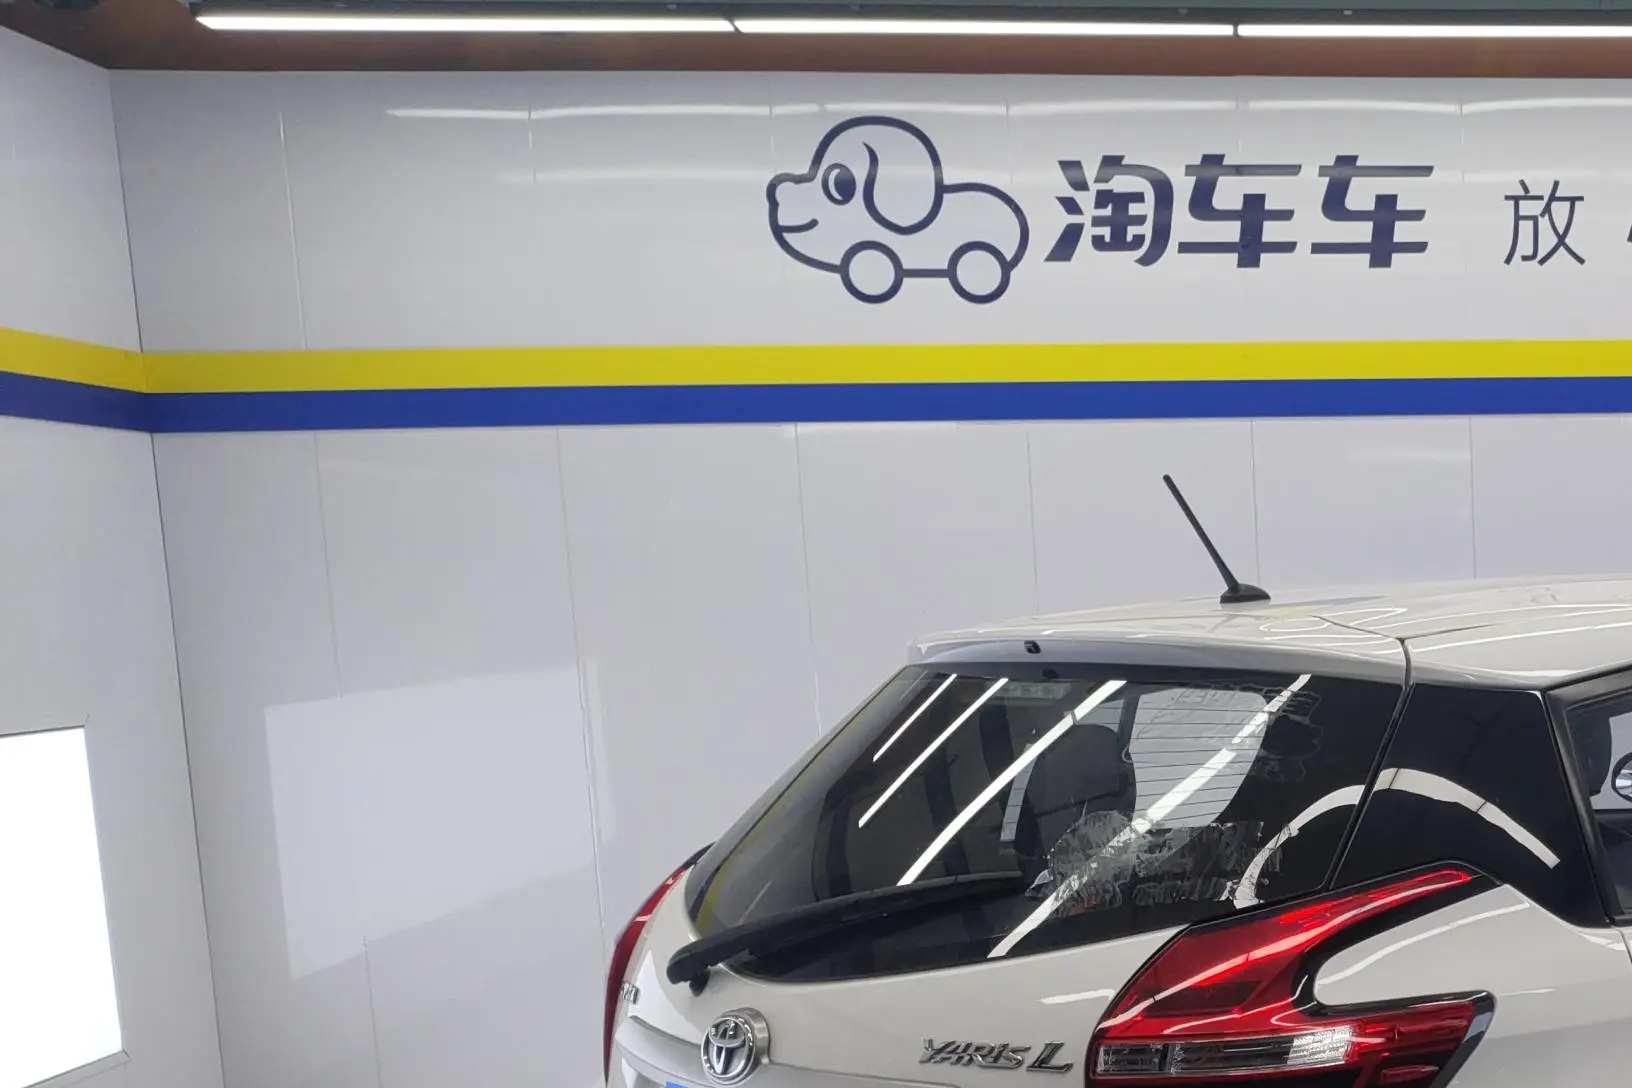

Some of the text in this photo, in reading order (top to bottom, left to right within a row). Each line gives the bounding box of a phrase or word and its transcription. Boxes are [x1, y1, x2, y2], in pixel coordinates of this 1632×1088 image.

[1045, 154, 1434, 268] 淘车车
[919, 1038, 1074, 1073] YARIS L
